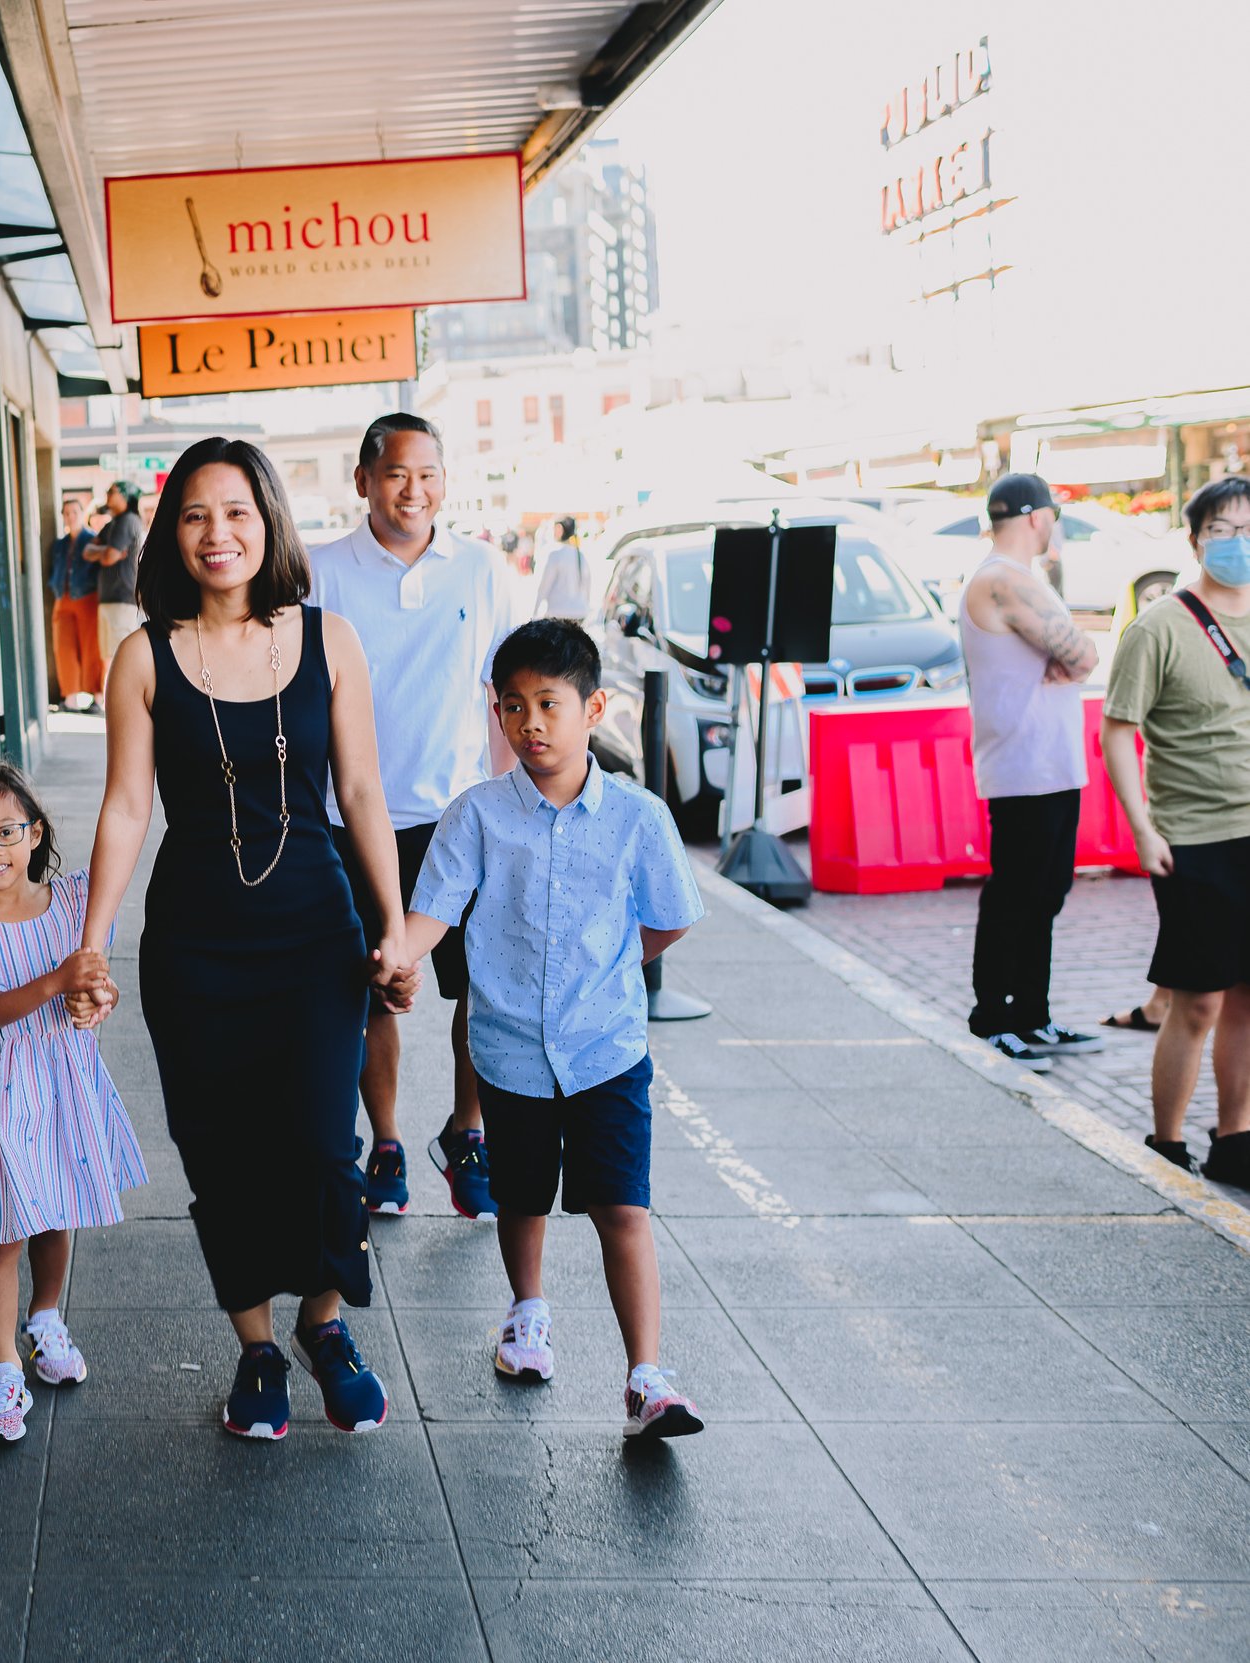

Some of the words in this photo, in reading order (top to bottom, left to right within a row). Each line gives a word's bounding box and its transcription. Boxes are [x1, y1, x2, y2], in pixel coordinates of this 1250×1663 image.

[227, 201, 432, 254] michou
[229, 264, 297, 277] WORLD
[309, 260, 373, 273] CLASS
[385, 256, 432, 269] DELI
[166, 333, 225, 375] Le
[245, 320, 397, 370] Panier
